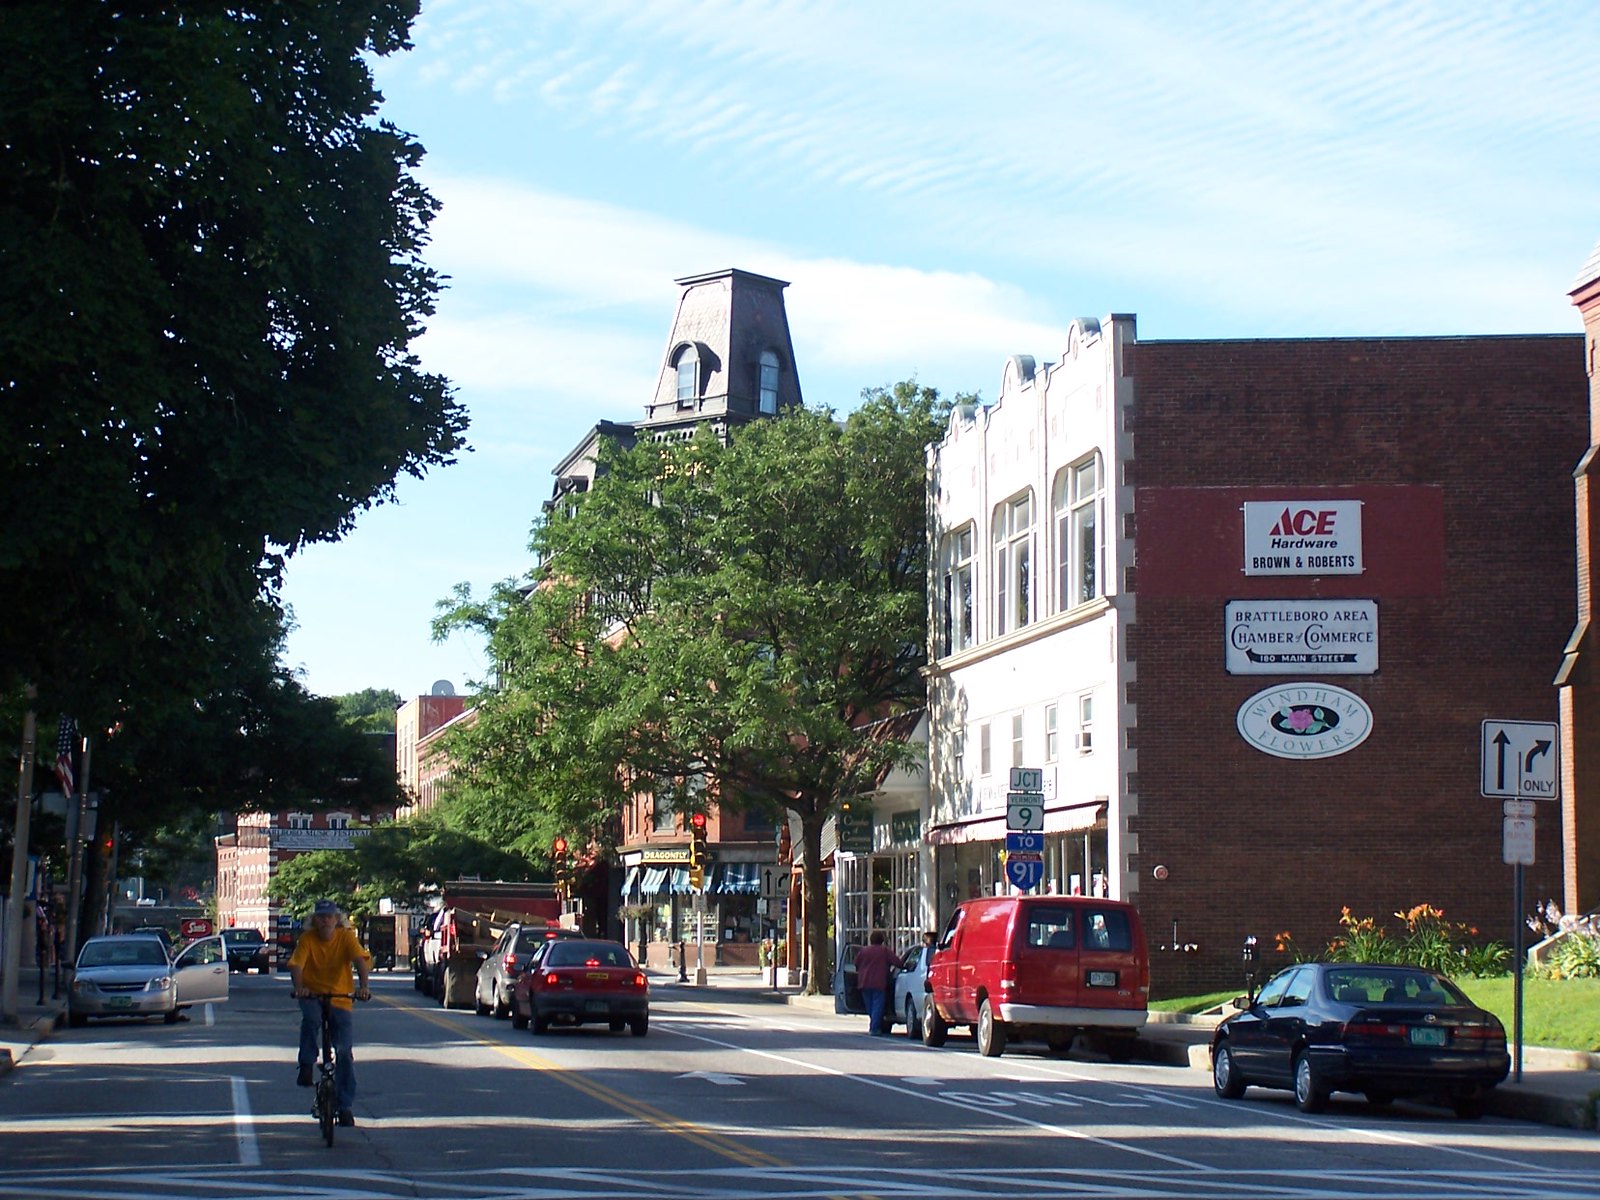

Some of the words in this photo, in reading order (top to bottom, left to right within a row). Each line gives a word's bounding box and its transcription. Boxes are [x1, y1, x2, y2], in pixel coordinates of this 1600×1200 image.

[1269, 507, 1337, 536] ACE
[1271, 538, 1338, 549] Hardware
[1253, 556, 1290, 569] BROWN
[1295, 556, 1303, 568] &
[1308, 555, 1355, 568] ROBERTS
[1235, 611, 1329, 622] BRATTLEBORO
[1333, 610, 1368, 622] AREA
[1231, 624, 1294, 650] CHAMBER
[1304, 624, 1374, 650] COMMERCE
[1260, 654, 1275, 662] 180
[1282, 654, 1306, 662] MAIN
[1311, 654, 1345, 662] STREET
[1252, 690, 1358, 718] WINDHAM
[1258, 729, 1355, 752] FLOWERS
[1014, 771, 1039, 787] JCT
[1523, 780, 1554, 792] ONLY
[1010, 796, 1041, 804] VERMONT
[1018, 807, 1032, 827] 9
[1017, 836, 1034, 848] TO
[644, 851, 688, 859] DRAGONFLY
[1013, 863, 1034, 883] 91
